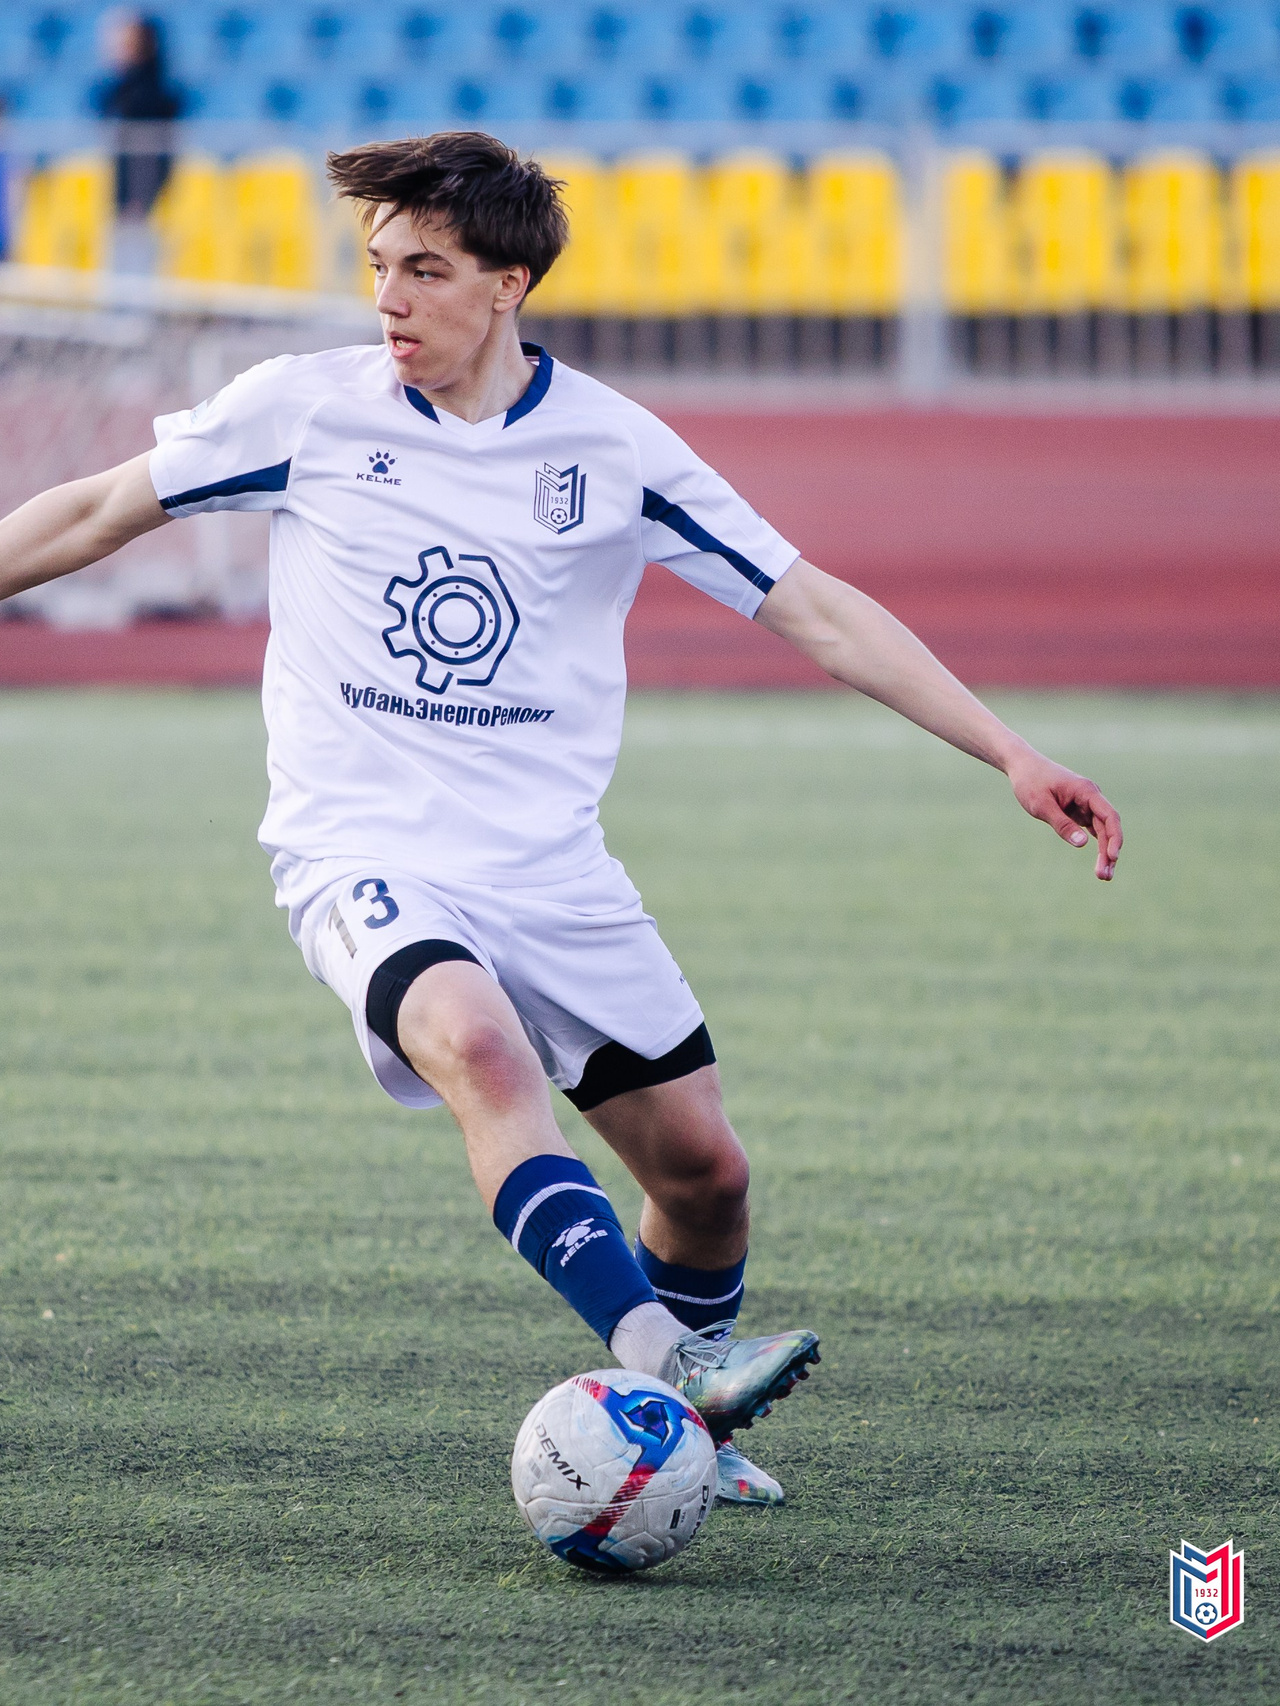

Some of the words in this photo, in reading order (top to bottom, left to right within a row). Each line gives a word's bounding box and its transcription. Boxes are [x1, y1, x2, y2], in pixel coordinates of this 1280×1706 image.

[356, 472, 402, 486] KELME
[550, 496, 569, 505] 1932
[340, 682, 555, 727] КубаньЭнергоРемонт
[328, 878, 400, 959] 13
[560, 1229, 608, 1267] KELME
[535, 1422, 591, 1491] DEMIX
